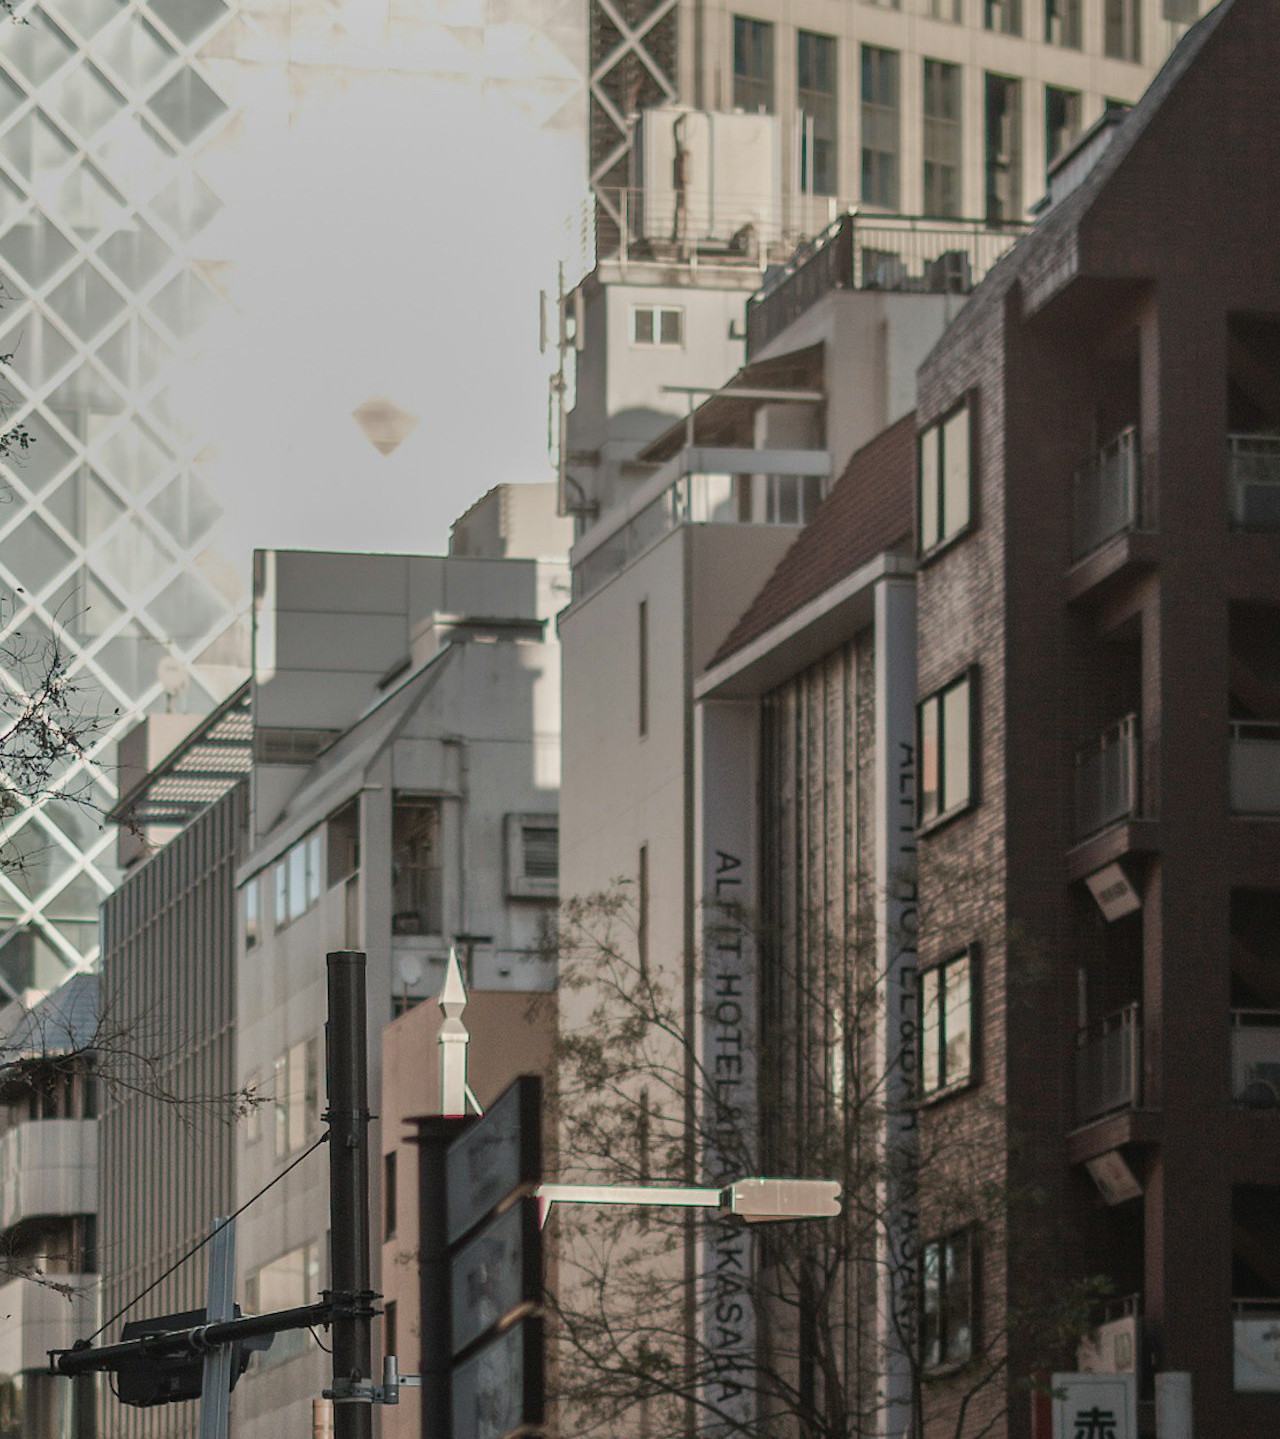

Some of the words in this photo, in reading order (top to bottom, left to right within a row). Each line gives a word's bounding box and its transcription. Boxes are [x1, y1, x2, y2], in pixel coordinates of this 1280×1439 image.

[715, 851, 742, 959] ALFIT
[715, 974, 742, 1180] HOTEL&BA
[715, 1222, 742, 1402] AKASAKA
